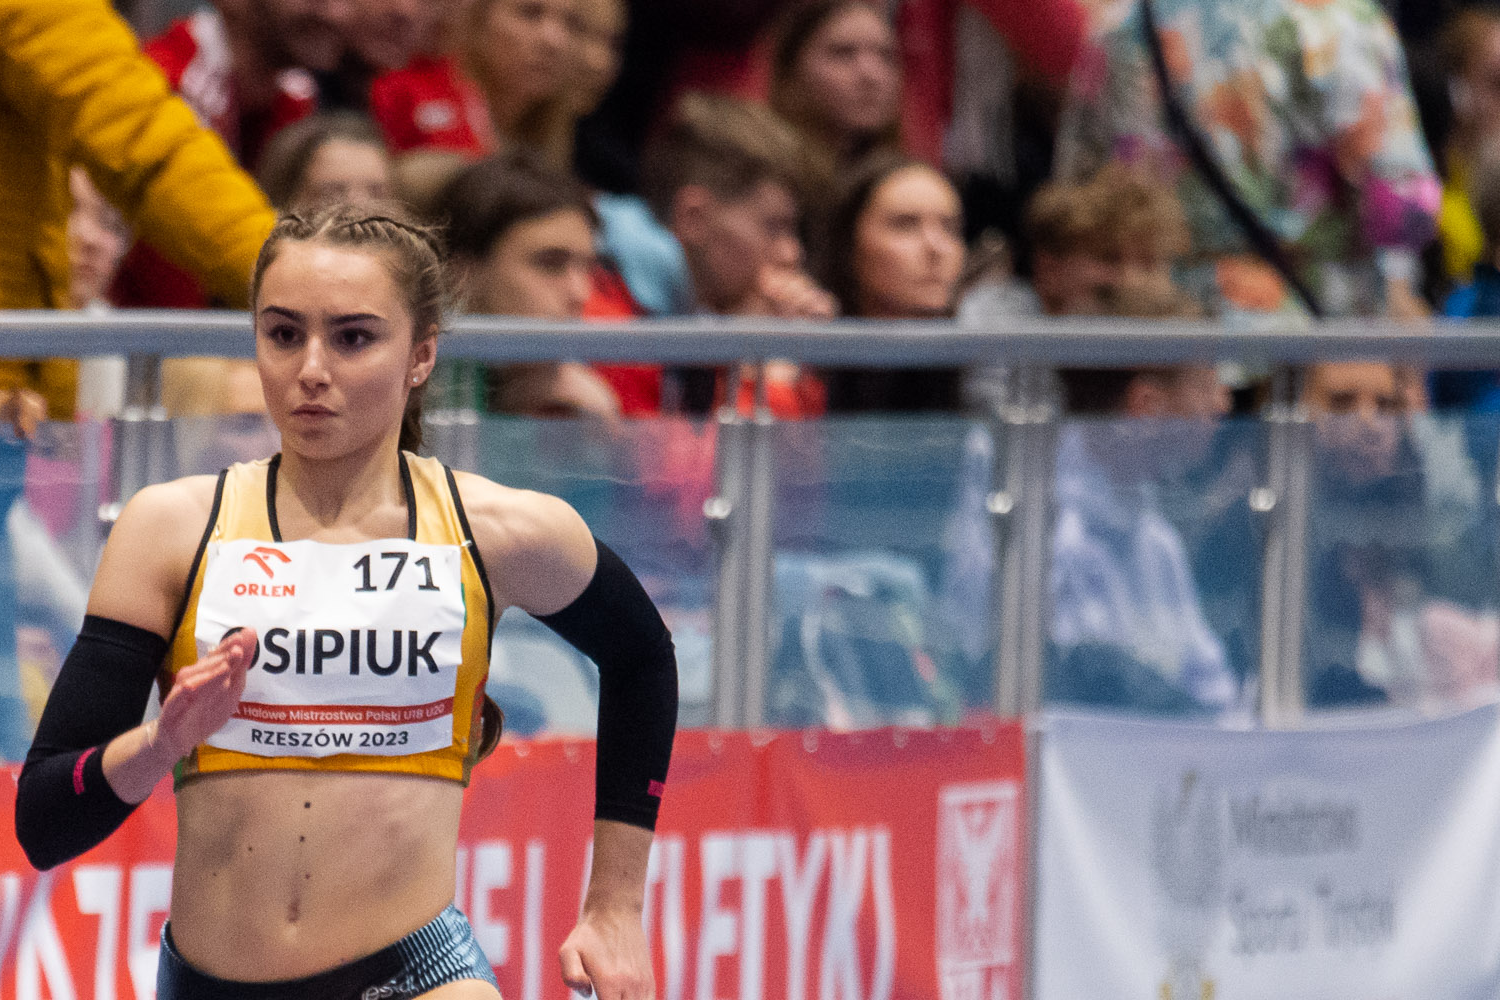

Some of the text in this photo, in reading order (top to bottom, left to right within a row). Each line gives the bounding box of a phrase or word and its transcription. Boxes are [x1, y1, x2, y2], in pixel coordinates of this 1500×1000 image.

[352, 551, 441, 593] 171
[233, 583, 296, 597] ORLEN
[243, 705, 287, 720] Halowe
[289, 709, 363, 722] Mistrzostwa
[366, 710, 401, 722] Polski
[425, 703, 445, 718] U20
[251, 728, 409, 748] RZESZÓW 2023
